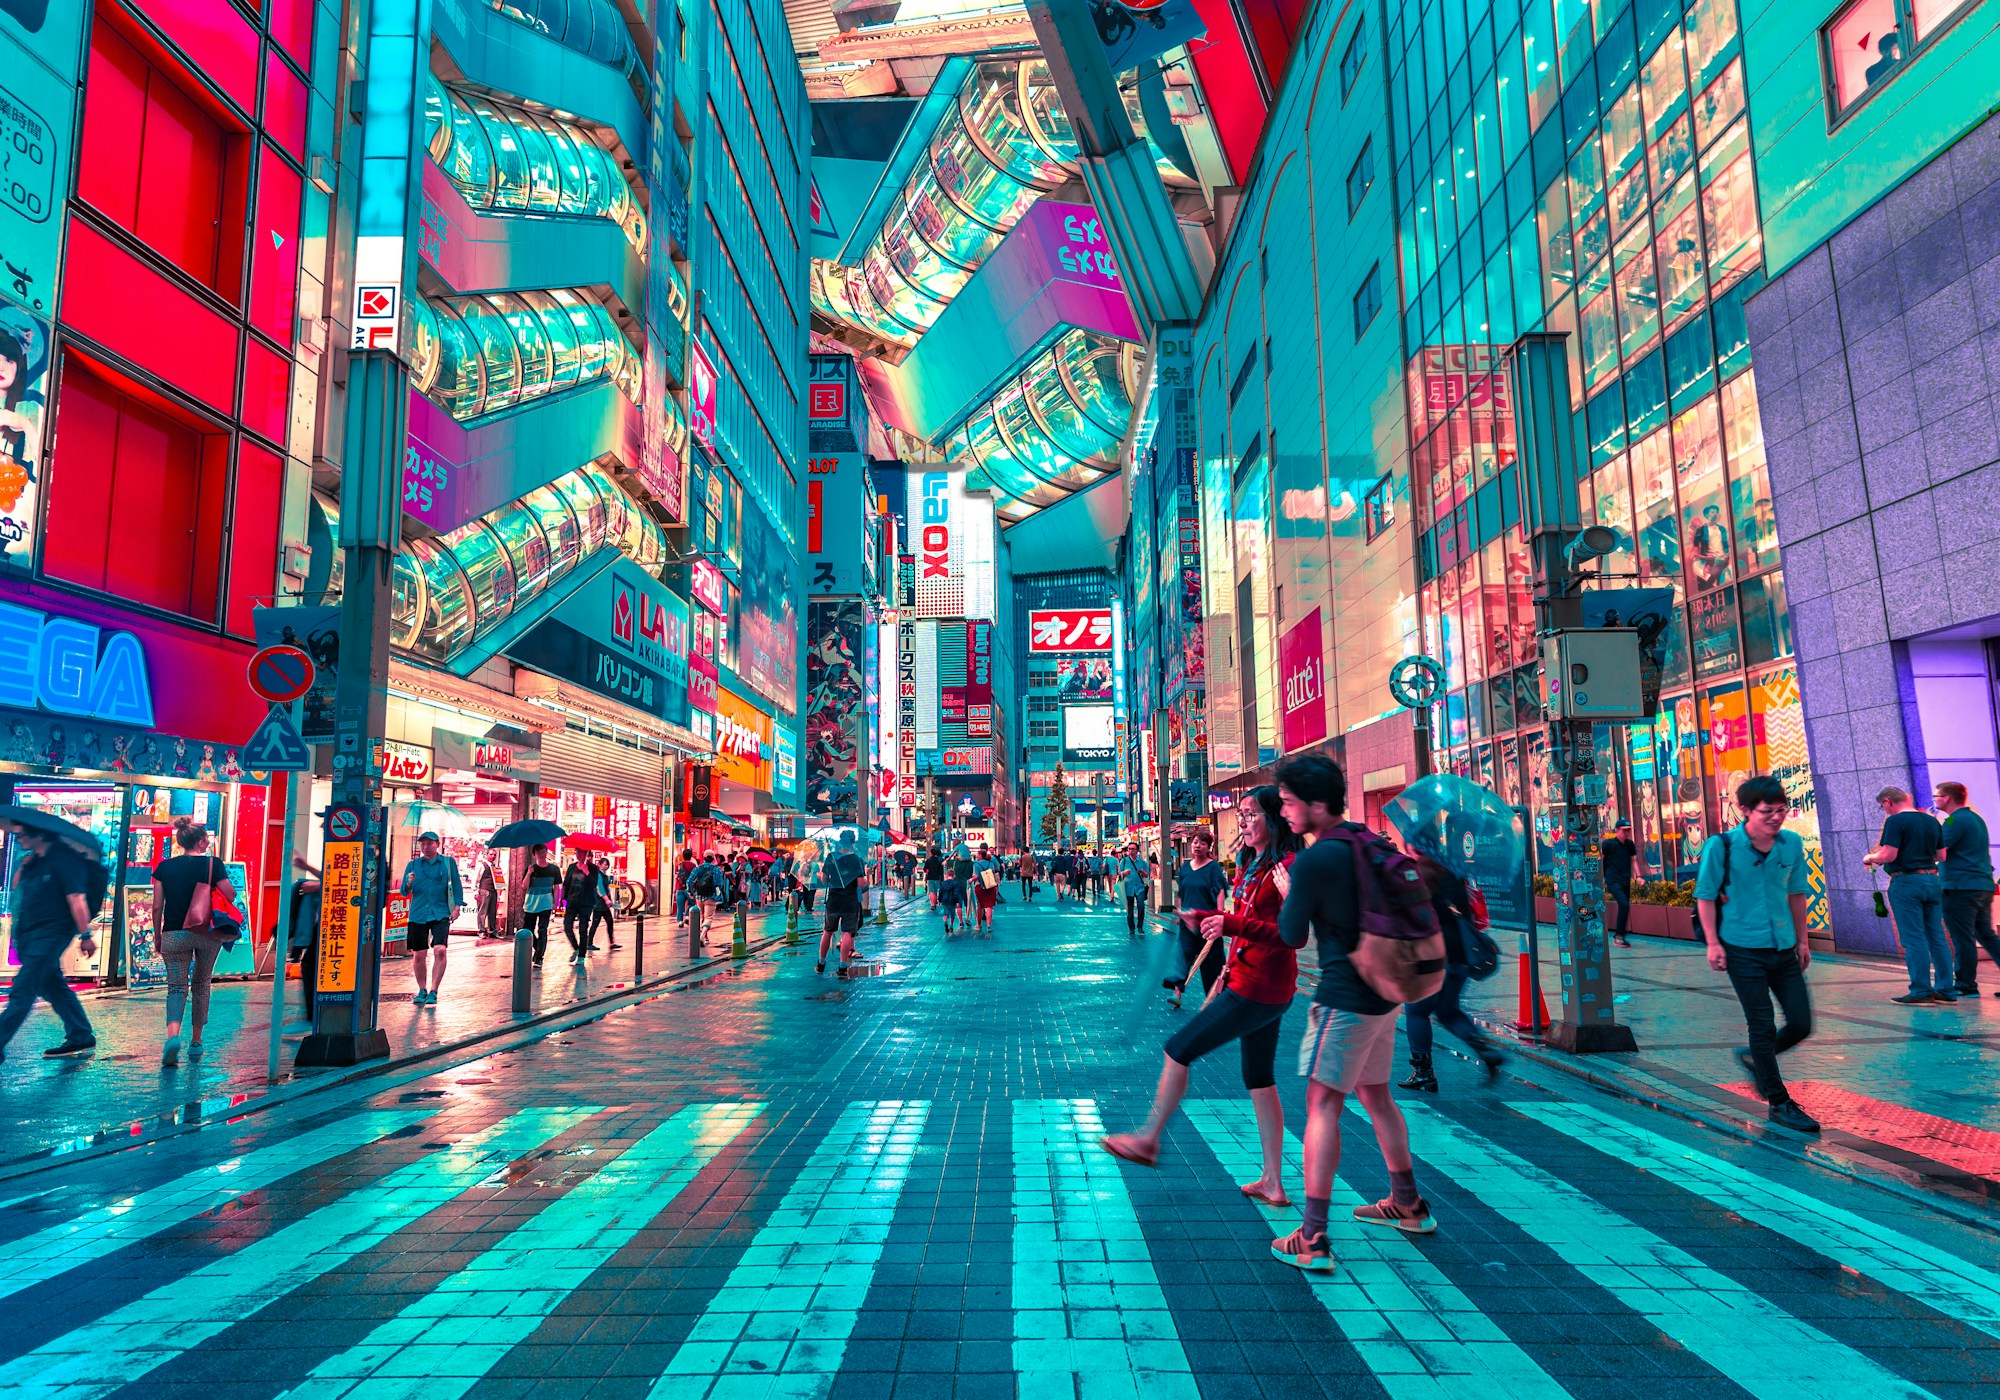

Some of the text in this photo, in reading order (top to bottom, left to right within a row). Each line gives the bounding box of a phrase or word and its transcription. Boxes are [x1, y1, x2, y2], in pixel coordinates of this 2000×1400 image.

[405, 446, 448, 490] カメラ
[404, 480, 433, 512] メラ
[1179, 494, 1191, 502] 7F
[900, 556, 908, 605] PARADISE
[907, 556, 915, 589] HOBBY
[639, 591, 688, 660] LABI
[639, 642, 687, 681] AKIHABARA
[974, 624, 990, 685] Duty Free
[595, 653, 653, 706] パソコン館
[695, 670, 718, 701] アイフル
[487, 744, 513, 765] LABI
[1076, 749, 1109, 758] TOKYO
[350, 846, 361, 891] 千代田区内は
[328, 852, 351, 988] 路上喫煙禁止です。
[389, 898, 410, 914] au
